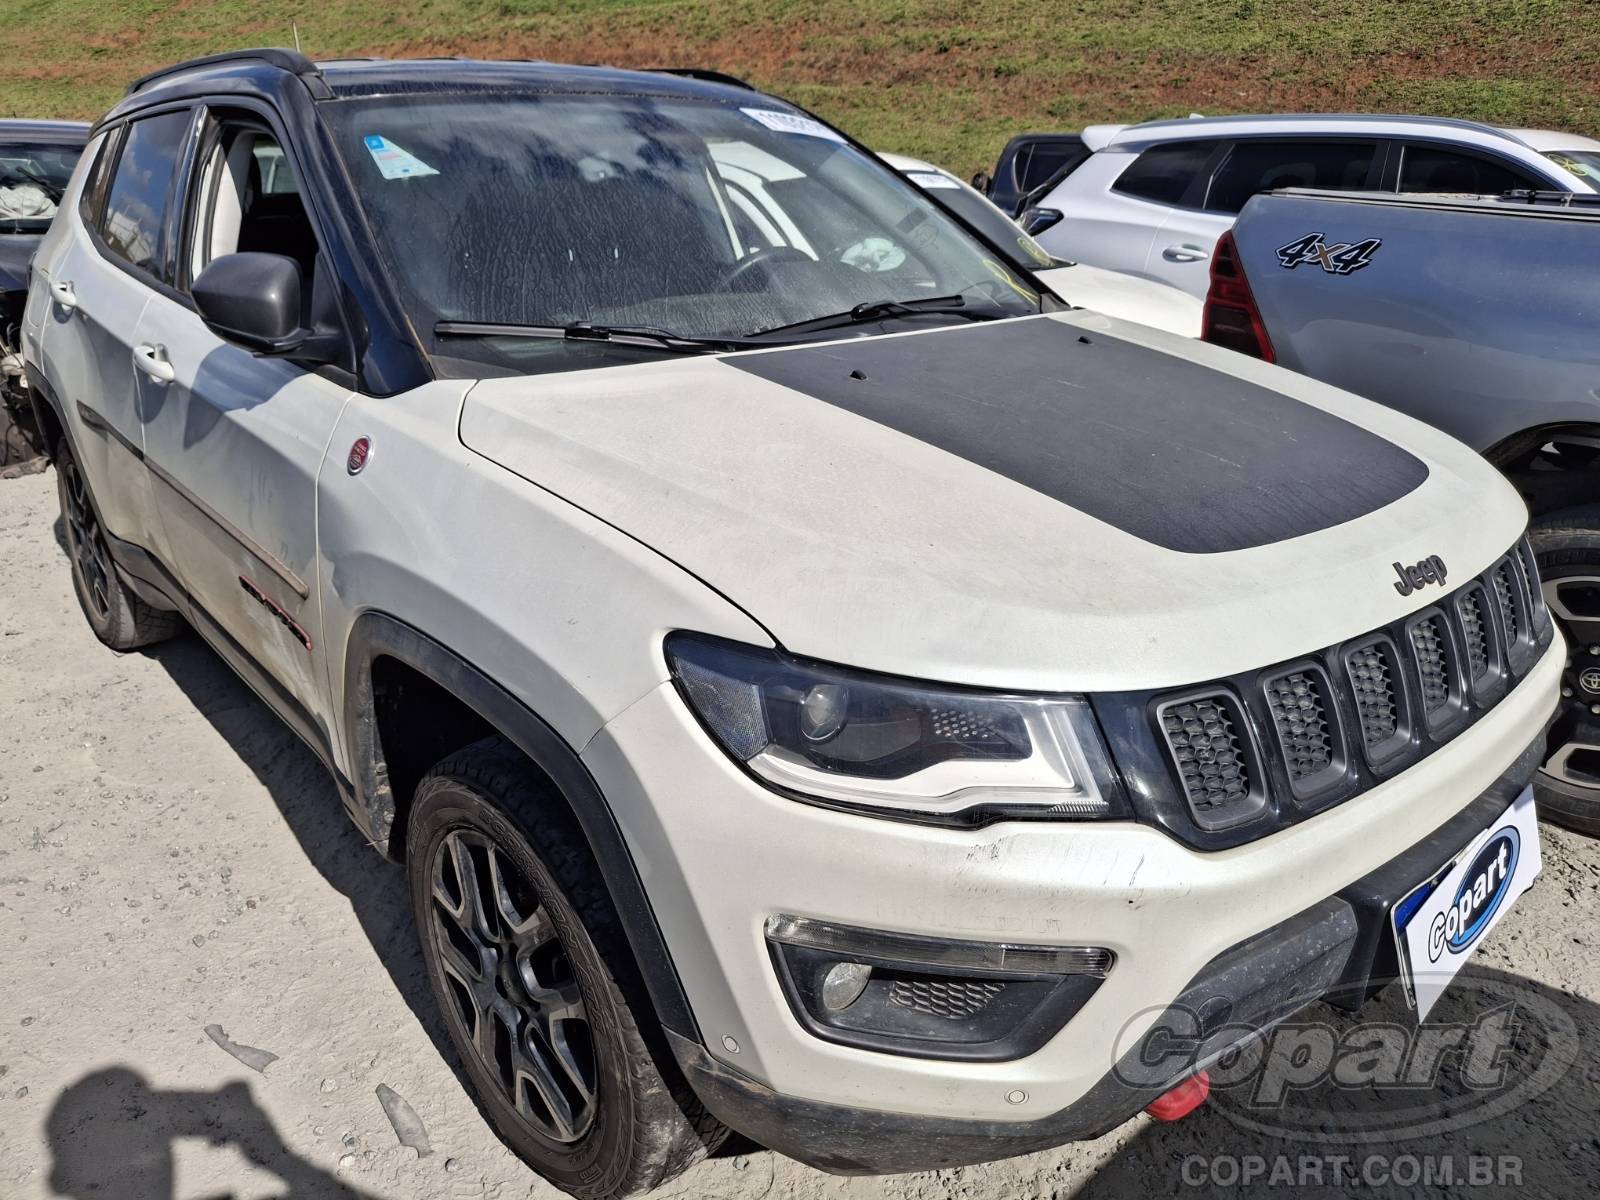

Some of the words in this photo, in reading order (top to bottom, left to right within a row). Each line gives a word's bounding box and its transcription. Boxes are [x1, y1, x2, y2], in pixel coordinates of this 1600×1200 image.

[1276, 232, 1382, 275] 4x4
[1392, 555, 1448, 597] Jeep
[1428, 841, 1508, 964] Copart
